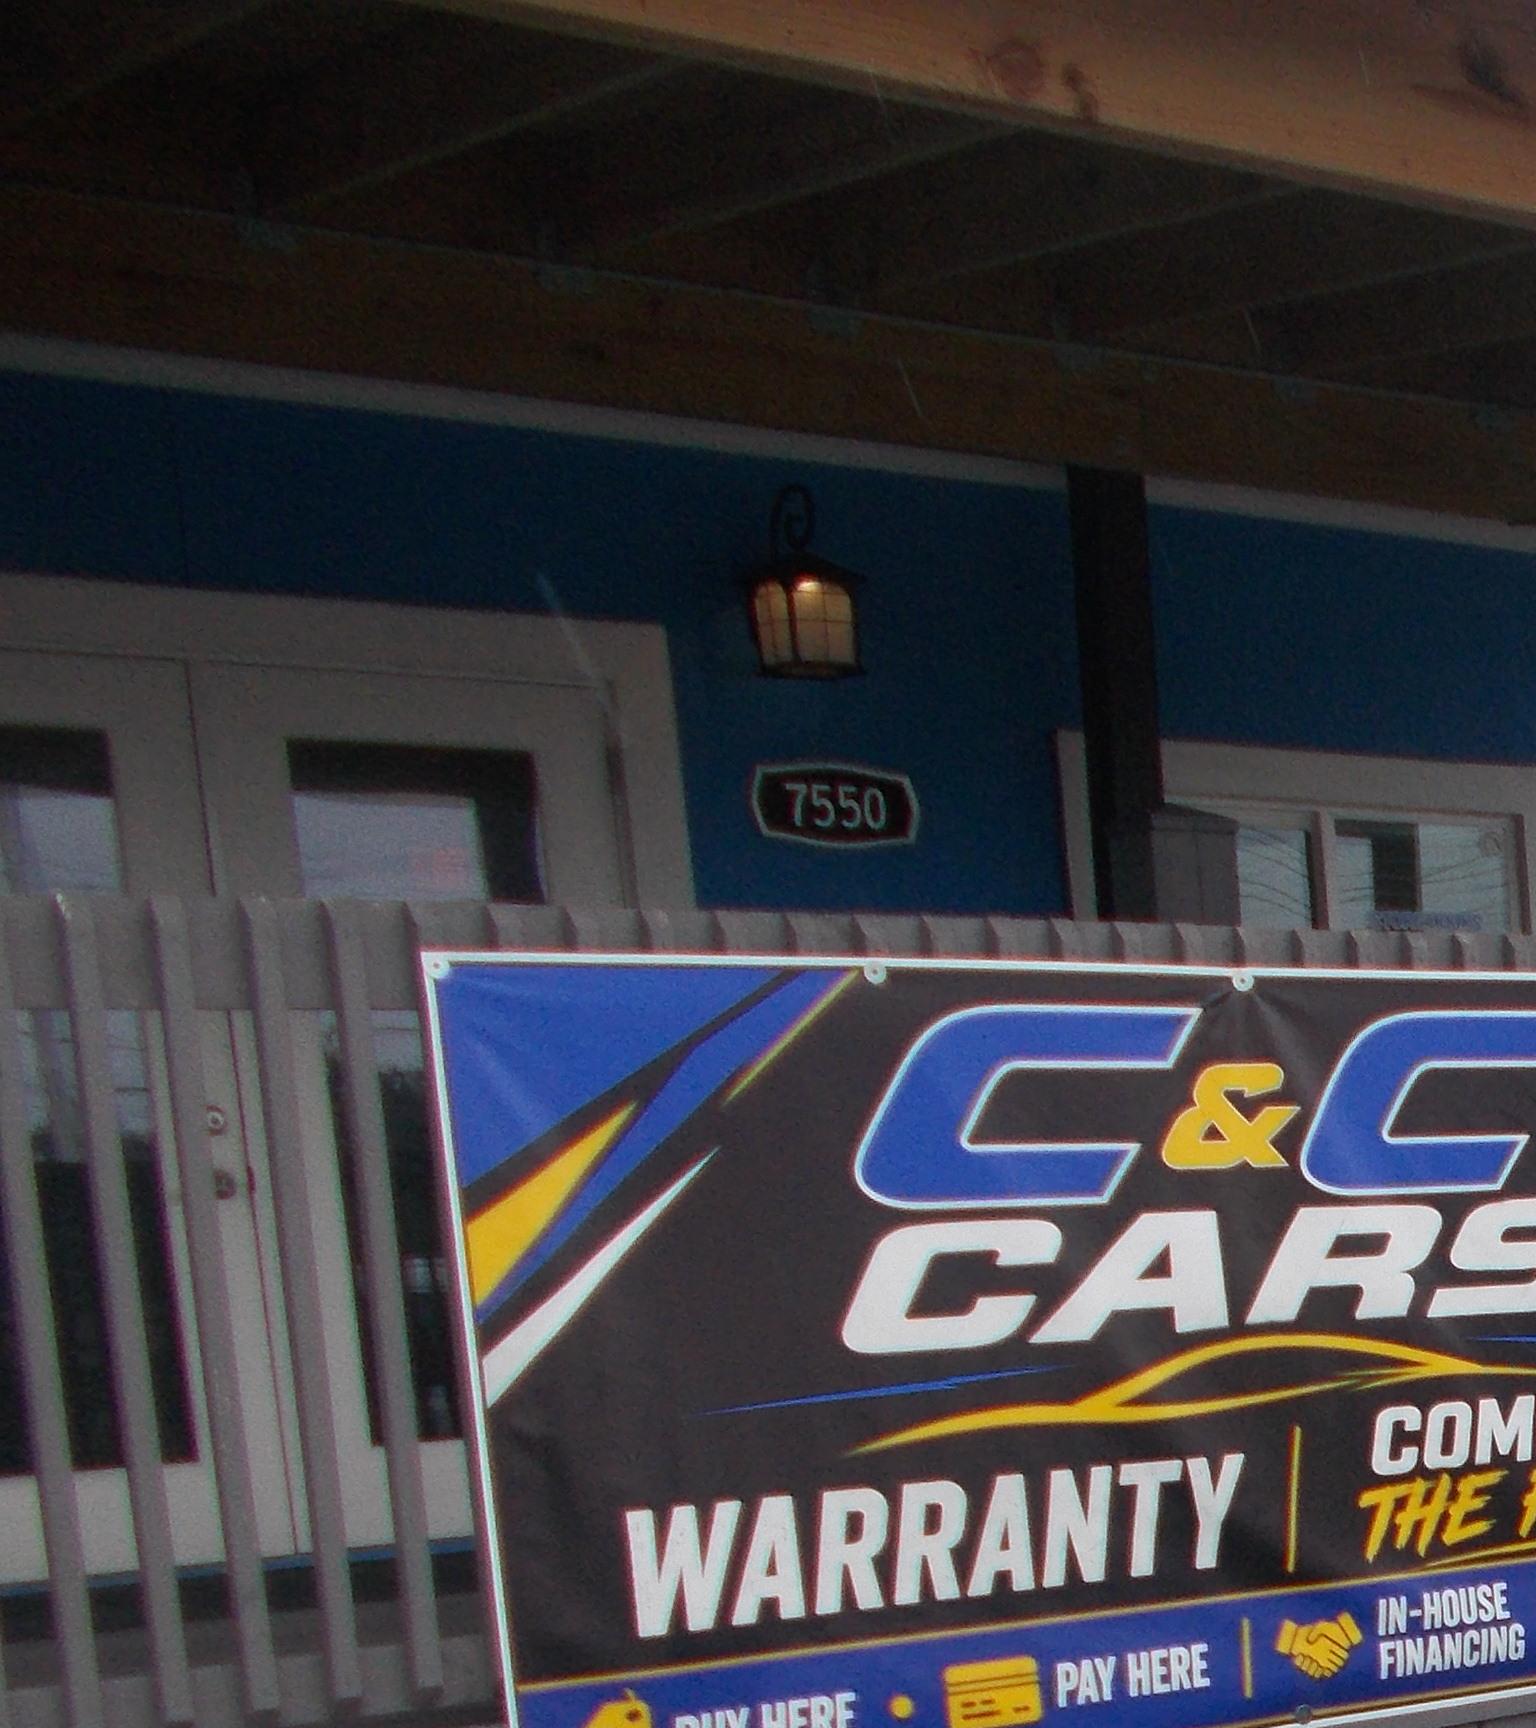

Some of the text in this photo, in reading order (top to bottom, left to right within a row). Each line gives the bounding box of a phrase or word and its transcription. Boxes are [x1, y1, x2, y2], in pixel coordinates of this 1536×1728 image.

[785, 783, 886, 830] 7550
[1357, 1468, 1507, 1563] THE
[625, 1453, 1245, 1639] WARRANTY
[1377, 1582, 1511, 1637] IN-HOUSE
[1056, 1644, 1211, 1708] PAY HERE
[1379, 1625, 1526, 1680] FINANCING
